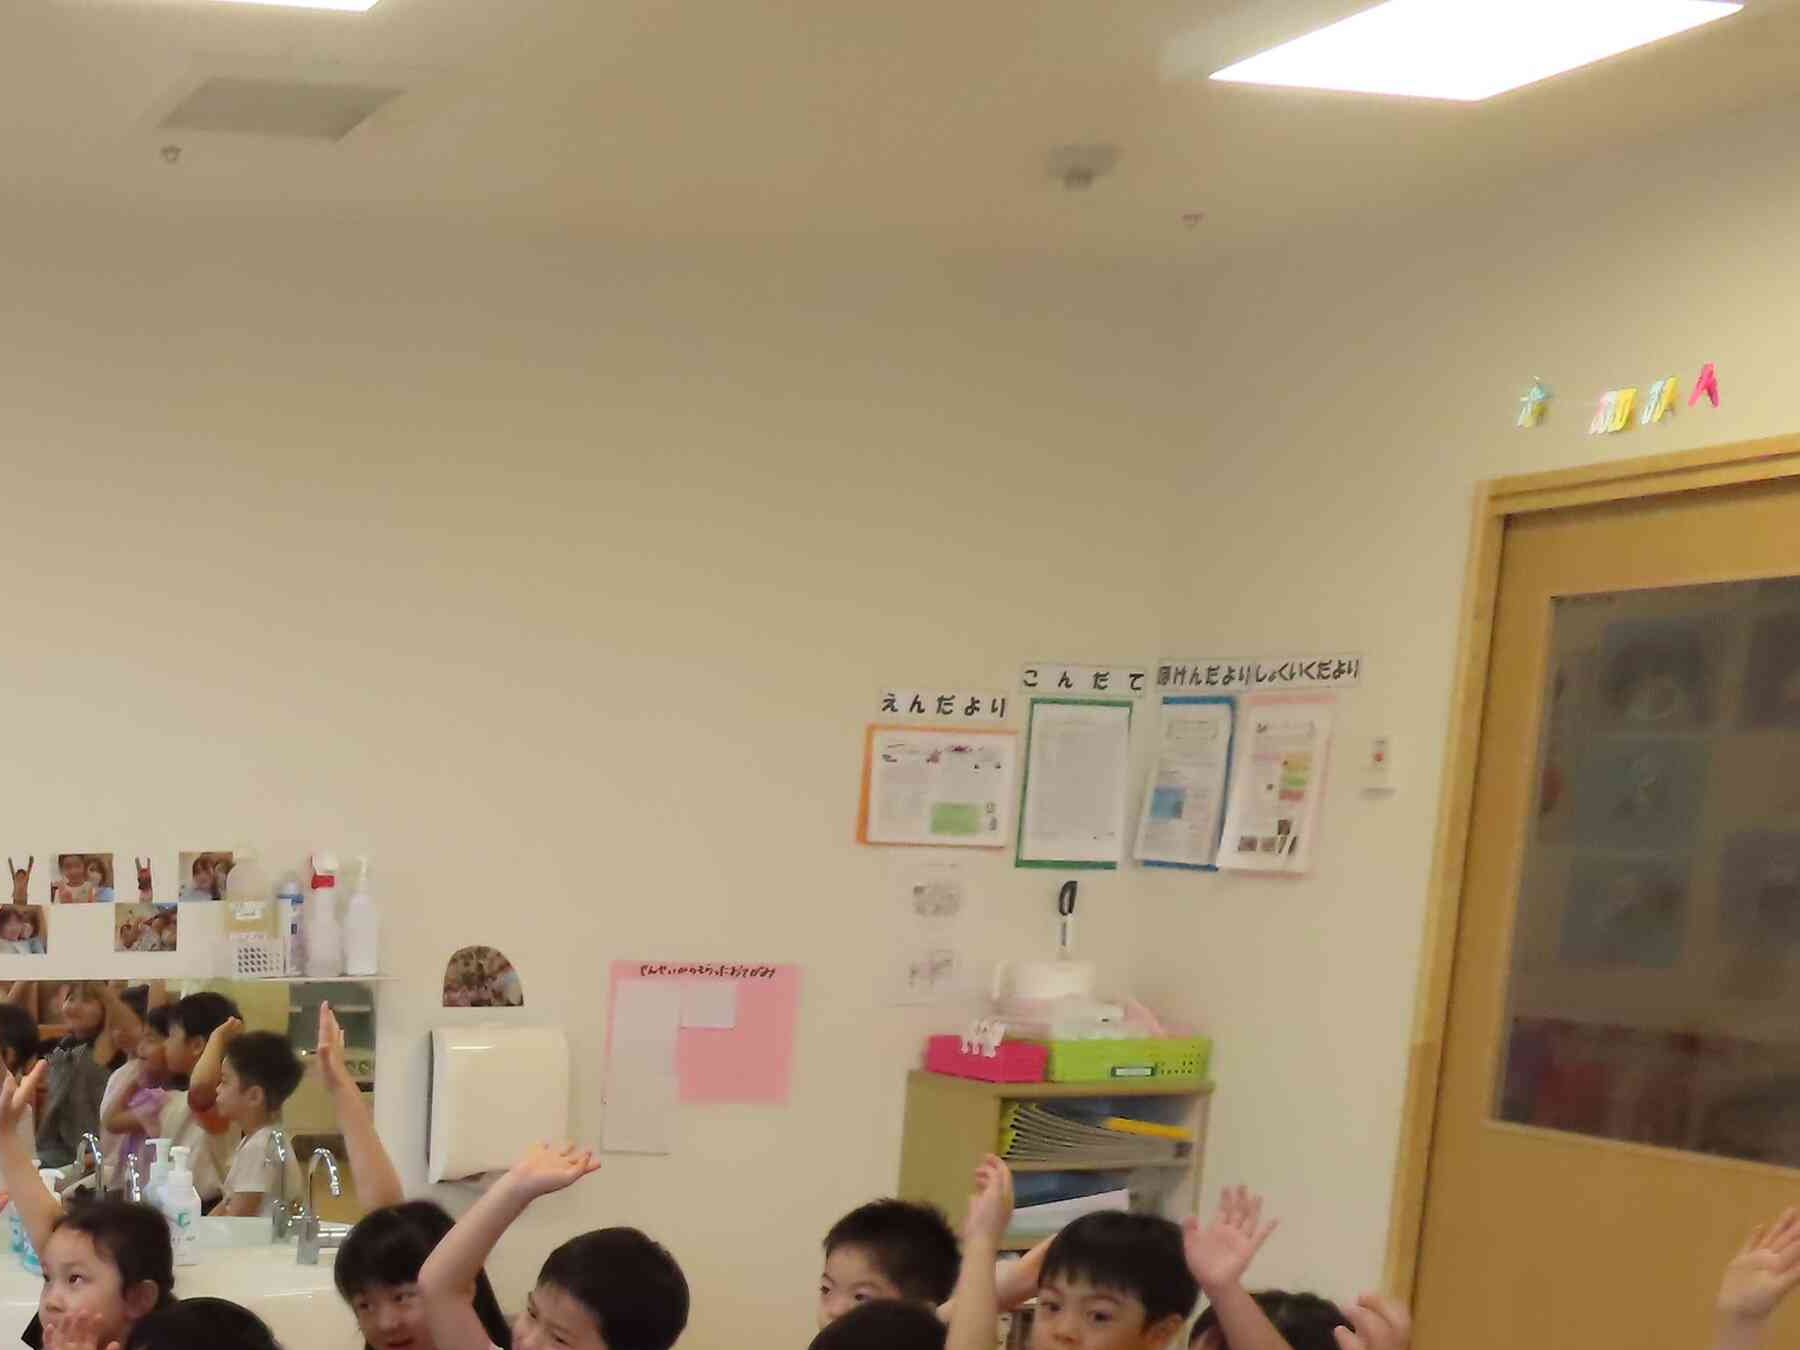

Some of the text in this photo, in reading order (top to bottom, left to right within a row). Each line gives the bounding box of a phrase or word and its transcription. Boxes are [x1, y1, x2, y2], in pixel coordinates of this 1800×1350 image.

[1022, 669, 1145, 691] こんだて
[881, 692, 1006, 718] えんだより
